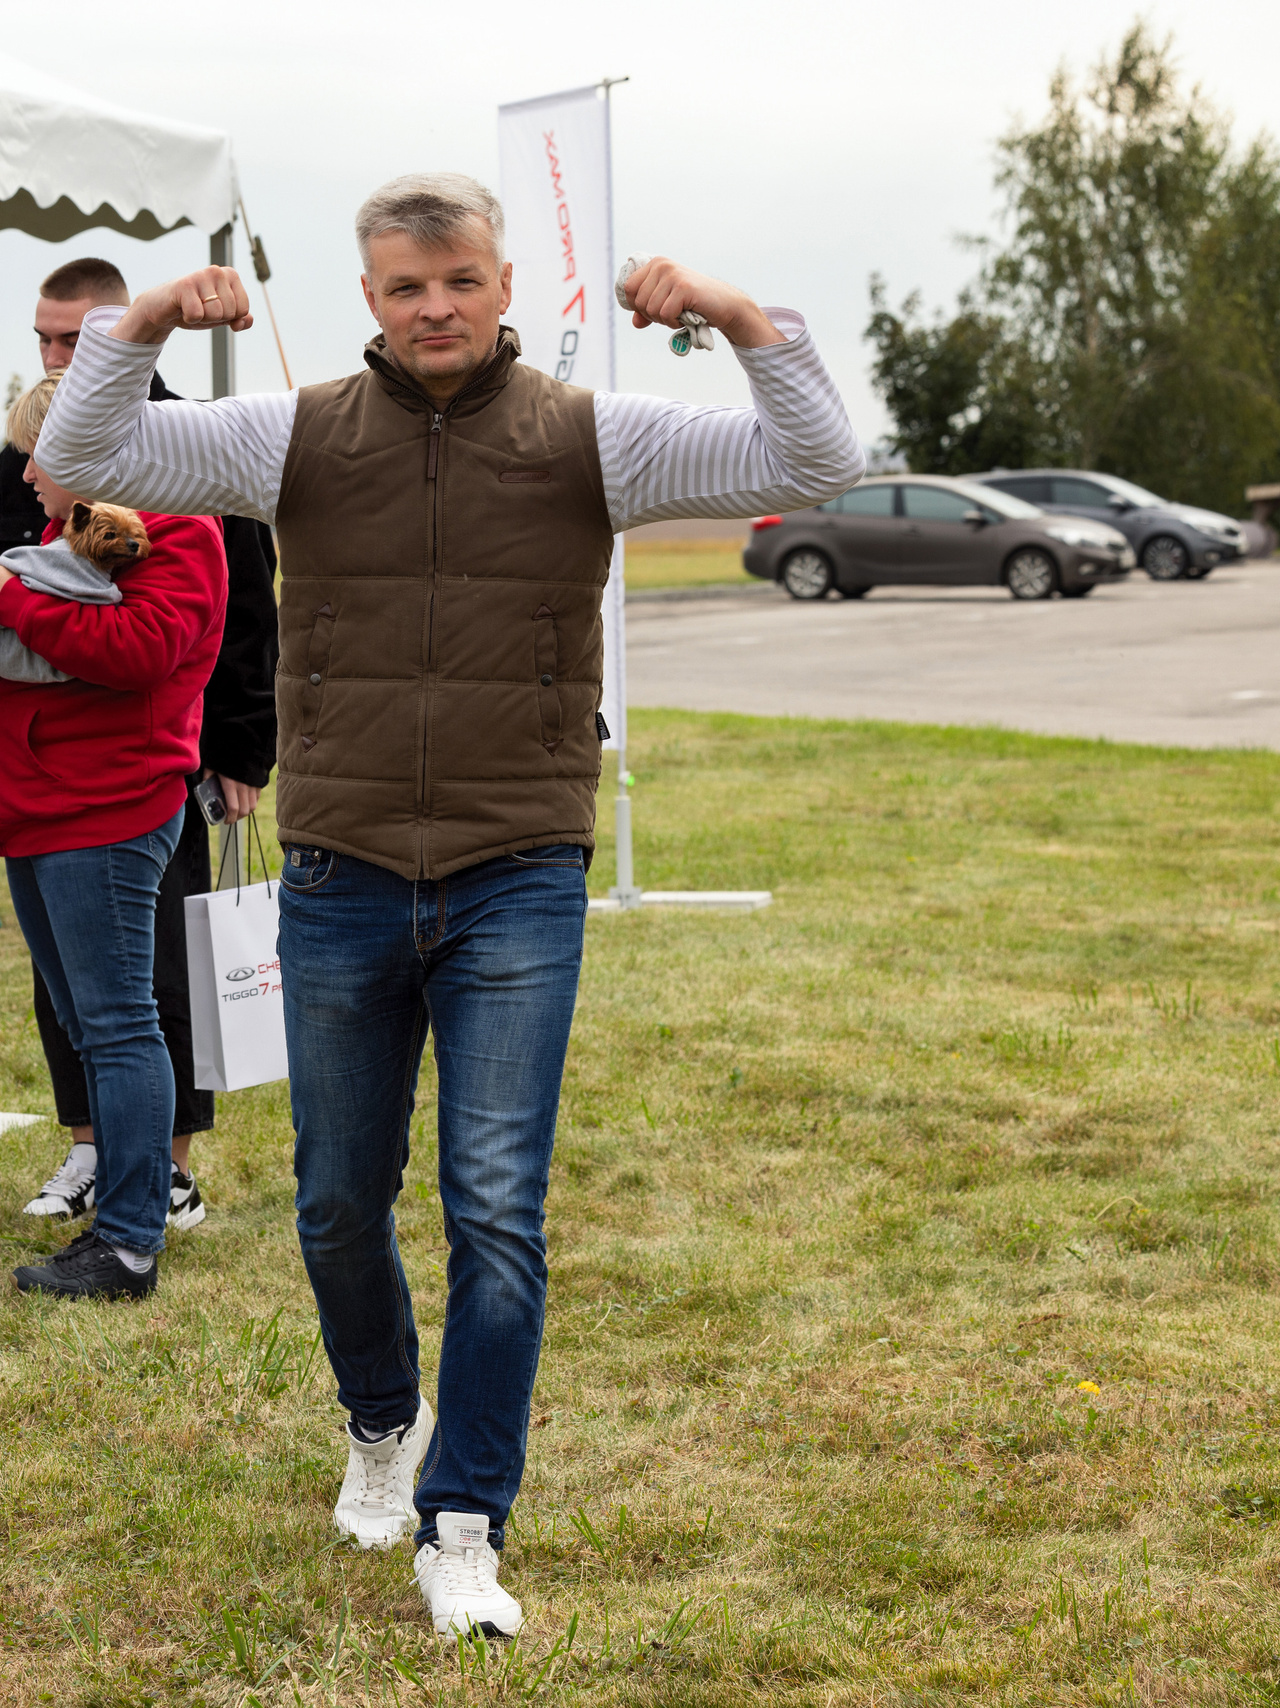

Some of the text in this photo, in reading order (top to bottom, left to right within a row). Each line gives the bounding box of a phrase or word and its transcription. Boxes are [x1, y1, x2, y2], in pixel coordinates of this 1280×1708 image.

[258, 960, 281, 974] CHE
[222, 988, 259, 1002] TIGGO
[259, 982, 269, 996] 7
